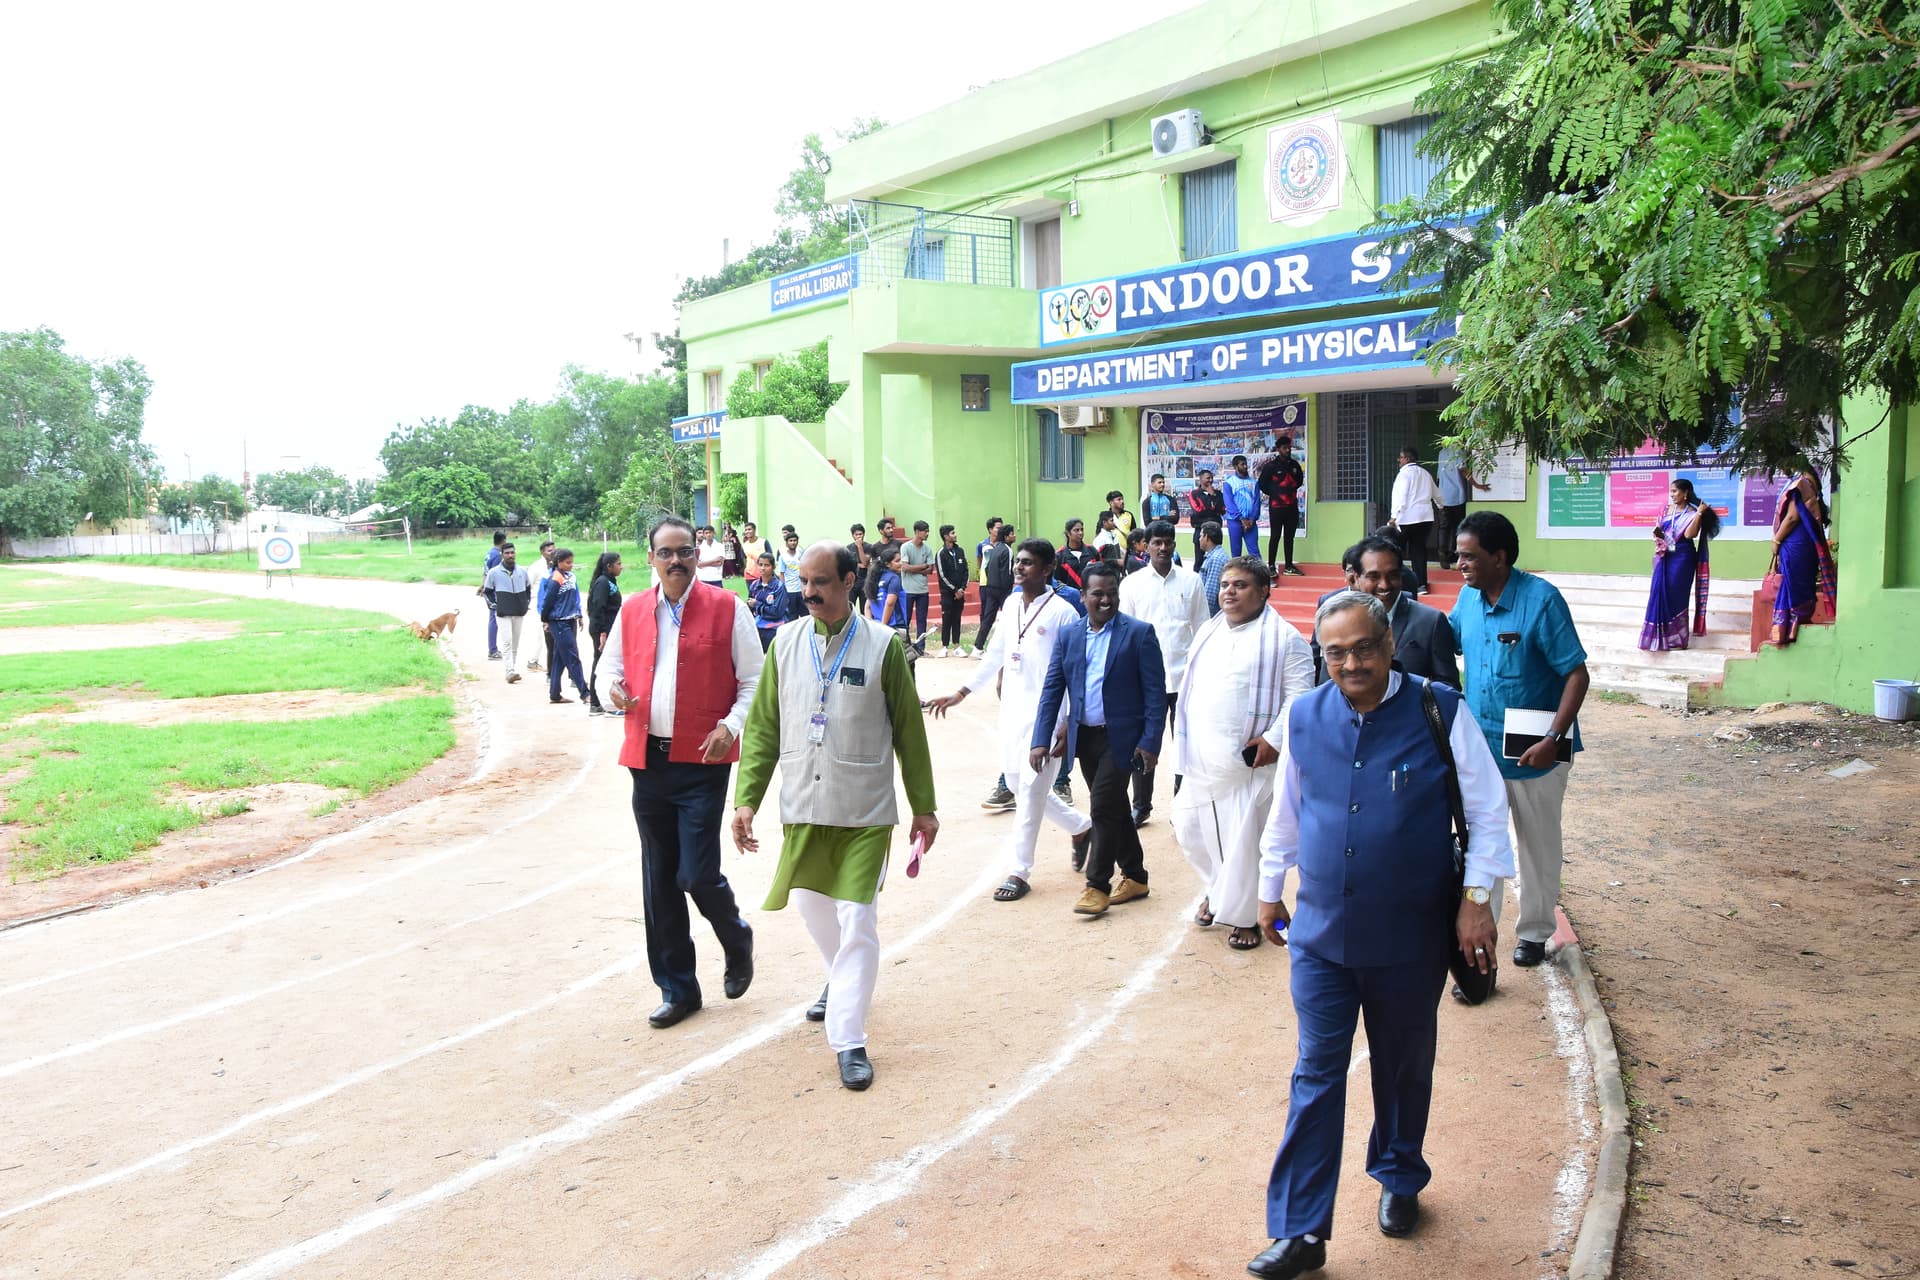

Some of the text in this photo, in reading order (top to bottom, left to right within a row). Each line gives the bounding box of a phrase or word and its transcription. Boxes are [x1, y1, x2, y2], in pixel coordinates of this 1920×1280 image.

[773, 281, 813, 305] CENTRAL
[813, 270, 854, 295] LIBRARY
[1120, 254, 1313, 319] INDOOR
[1038, 321, 1417, 393] DEPARTMENT OF PHYSICAL
